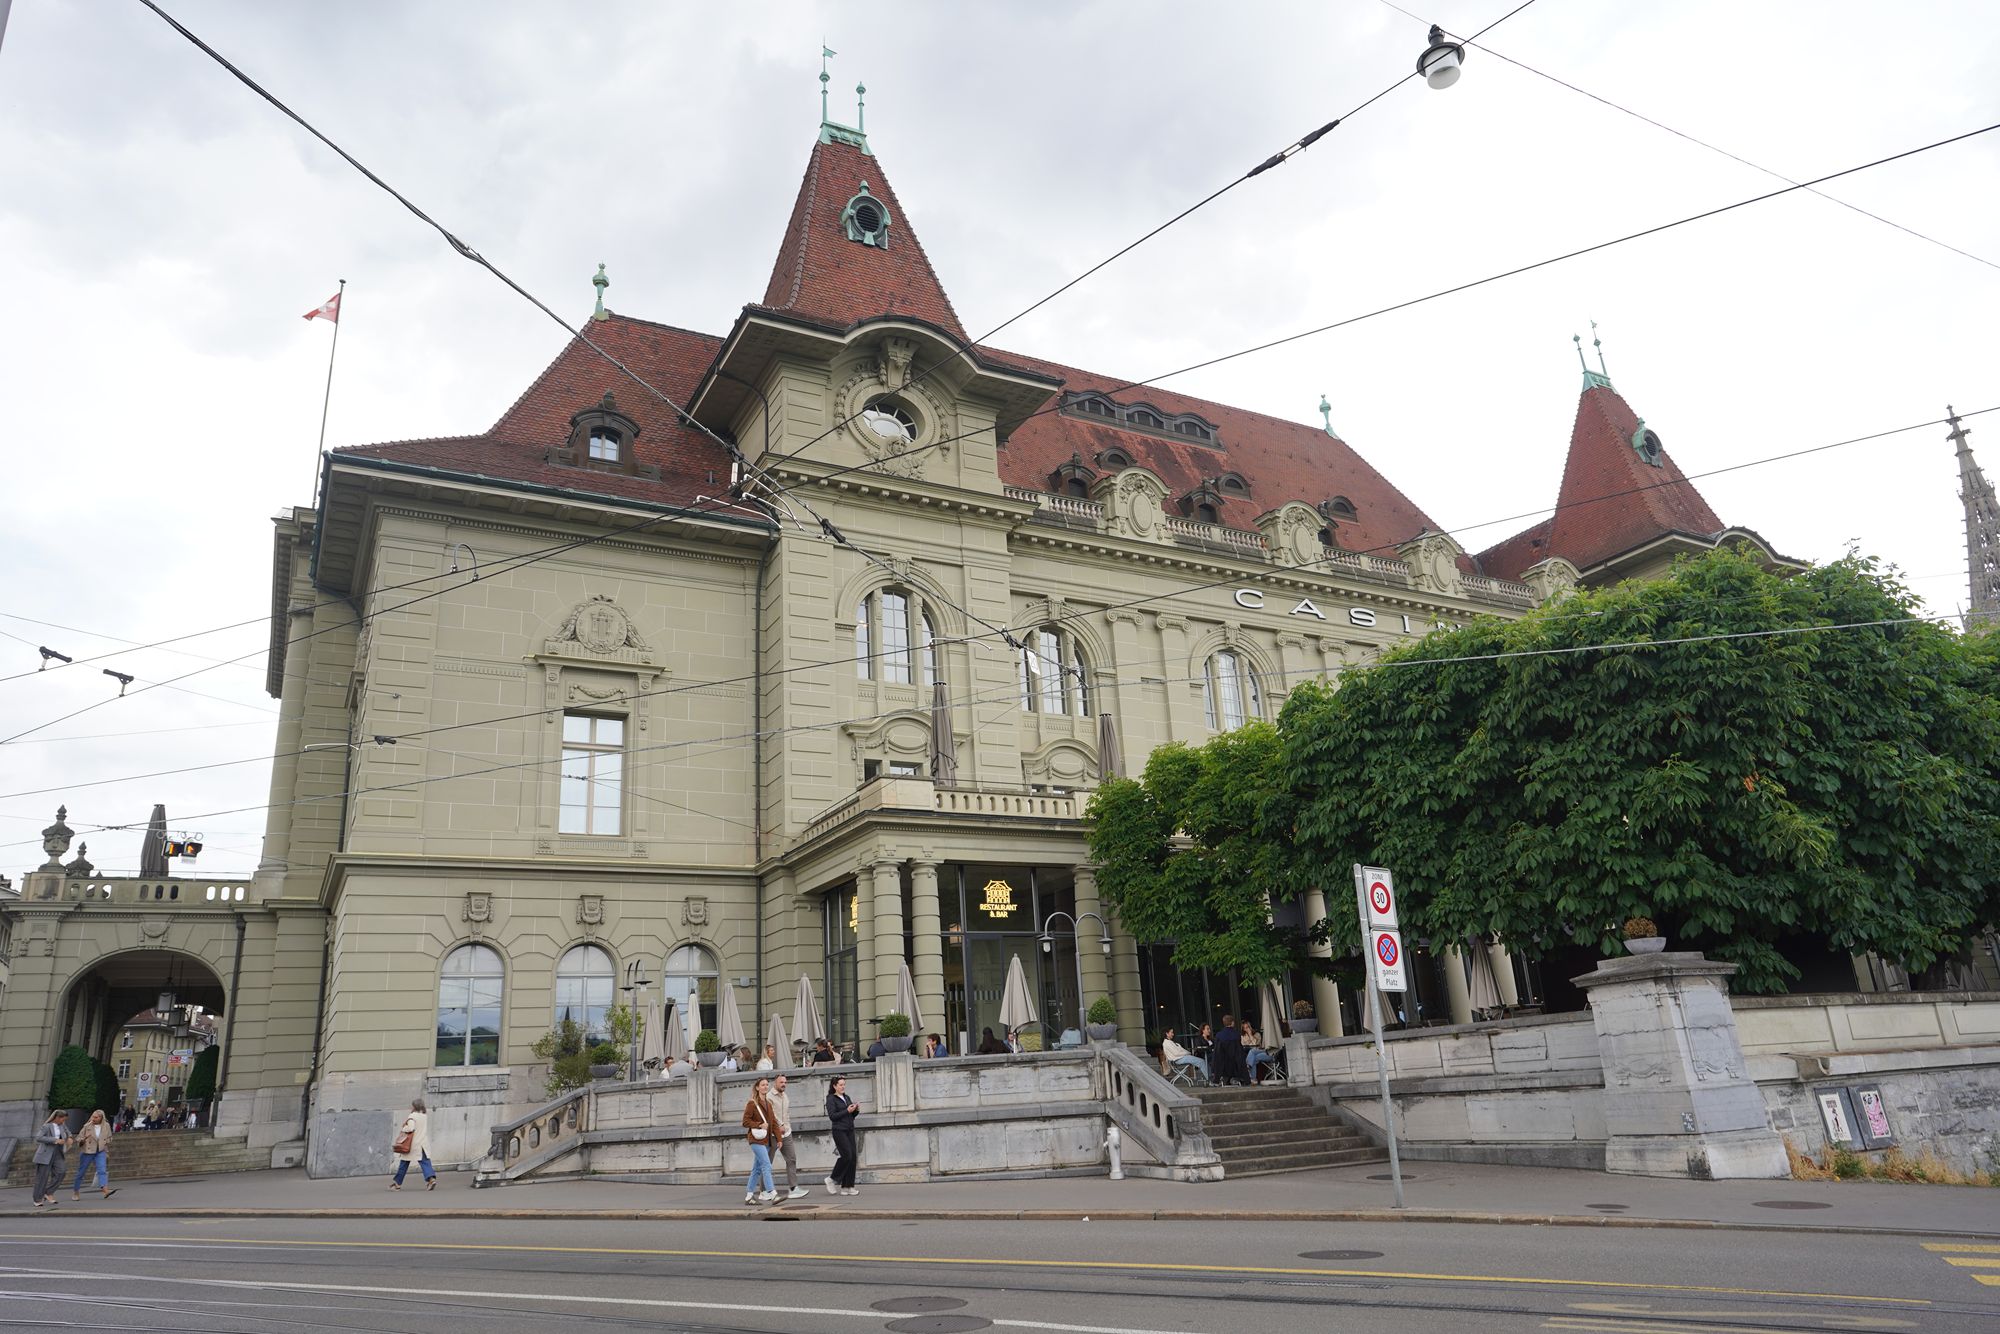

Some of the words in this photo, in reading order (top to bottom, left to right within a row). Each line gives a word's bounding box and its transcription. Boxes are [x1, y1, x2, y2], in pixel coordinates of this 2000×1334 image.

[1371, 872, 1384, 880] ZONE
[1376, 892, 1385, 903] 30
[1382, 969, 1399, 978] ganzer
[1386, 978, 1398, 986] Platz
